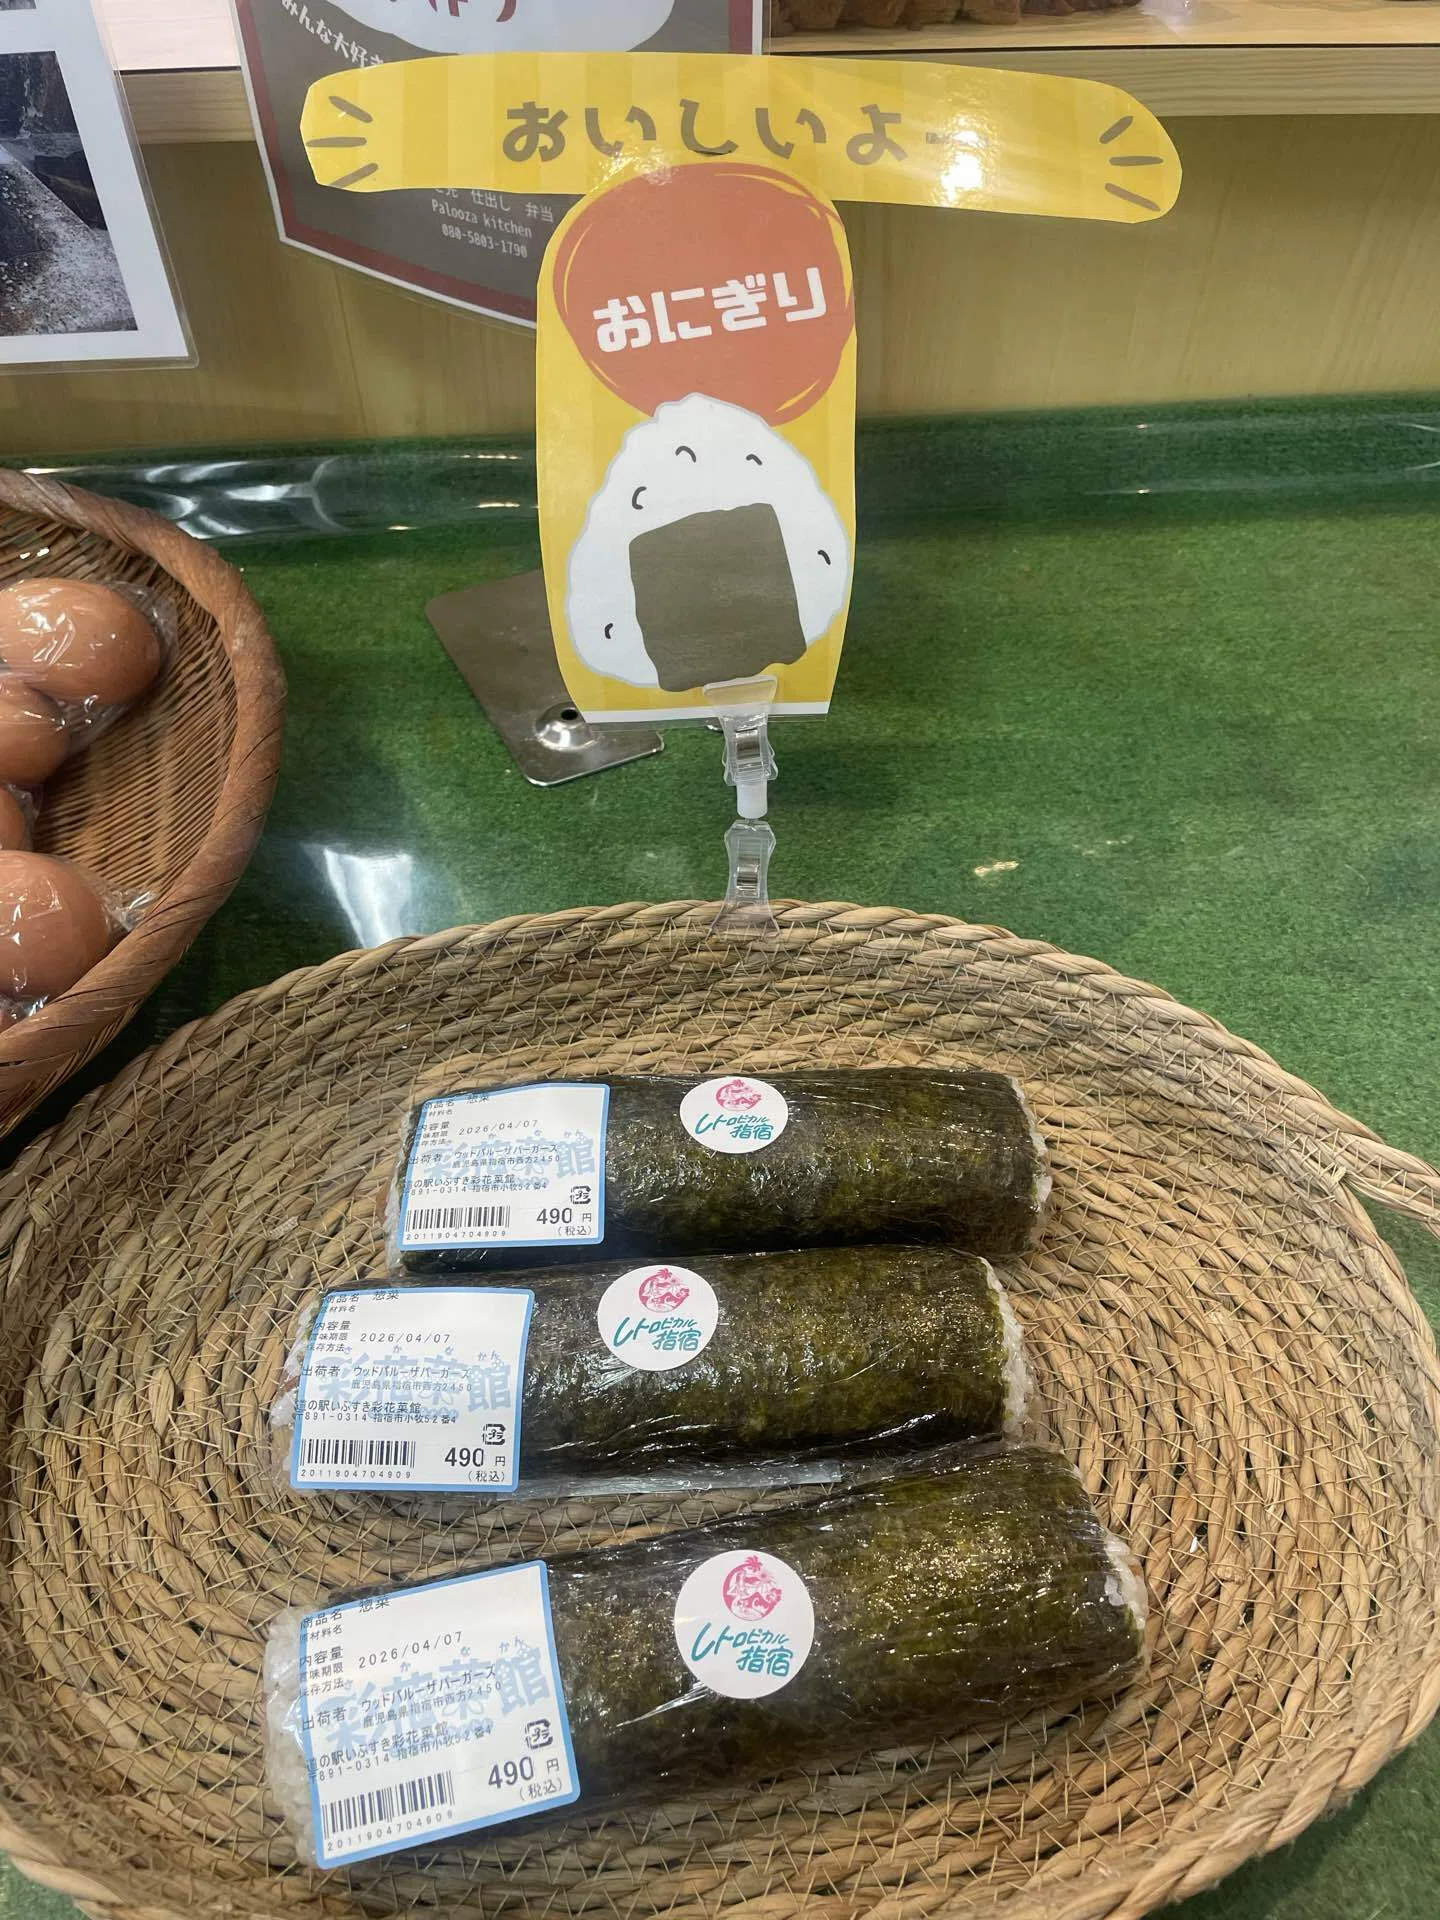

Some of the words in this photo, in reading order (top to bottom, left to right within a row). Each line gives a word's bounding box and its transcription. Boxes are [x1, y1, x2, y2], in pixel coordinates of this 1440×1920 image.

[431, 198, 479, 224] Palooza
[524, 201, 554, 223] 弁当
[441, 223, 528, 259] 080-5803-1790
[593, 266, 827, 352] おにぎり
[458, 1119, 538, 1136] 2026/04/07
[730, 1123, 774, 1140] 指宿
[536, 1207, 573, 1225] 490
[582, 1213, 593, 1222] 円
[360, 1332, 452, 1344] 2026/04/07
[651, 1328, 702, 1351] 指宿
[302, 1365, 341, 1377] 出荷者
[444, 1447, 484, 1467] 490
[495, 1456, 506, 1466] 円
[300, 1468, 411, 1479] 2011904704909
[299, 1646, 344, 1667] 内容量
[358, 1631, 464, 1669] 2026/04/07
[736, 1646, 793, 1677] 指宿
[302, 1706, 347, 1730] 出荷者
[488, 1756, 534, 1790] 490
[546, 1758, 561, 1773] 円
